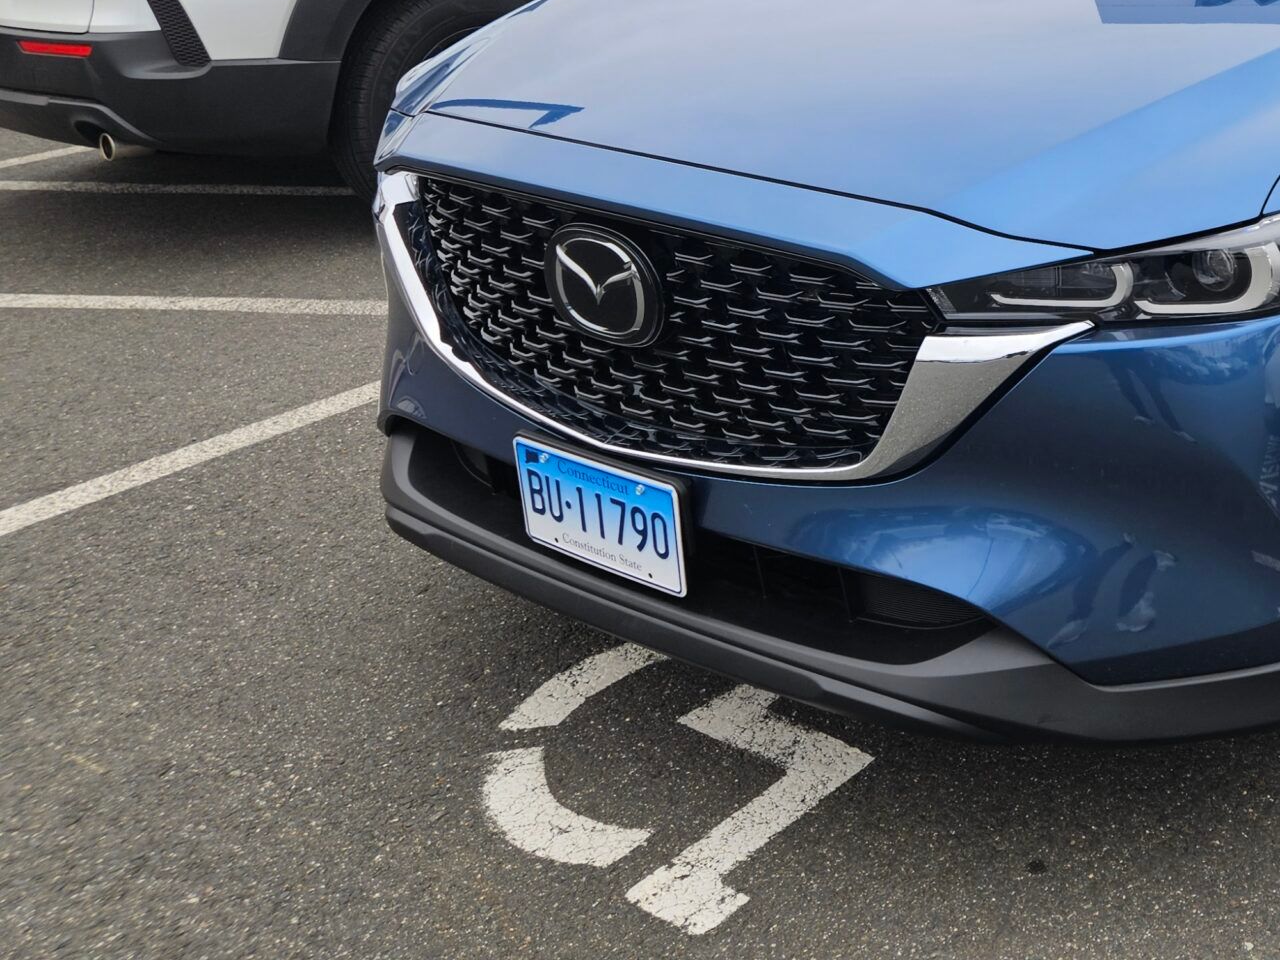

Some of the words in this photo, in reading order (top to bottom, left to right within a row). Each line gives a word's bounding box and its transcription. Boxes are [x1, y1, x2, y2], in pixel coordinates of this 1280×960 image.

[557, 460, 631, 496] Connecticut
[562, 532, 617, 562] Constitution
[618, 553, 643, 572] State
